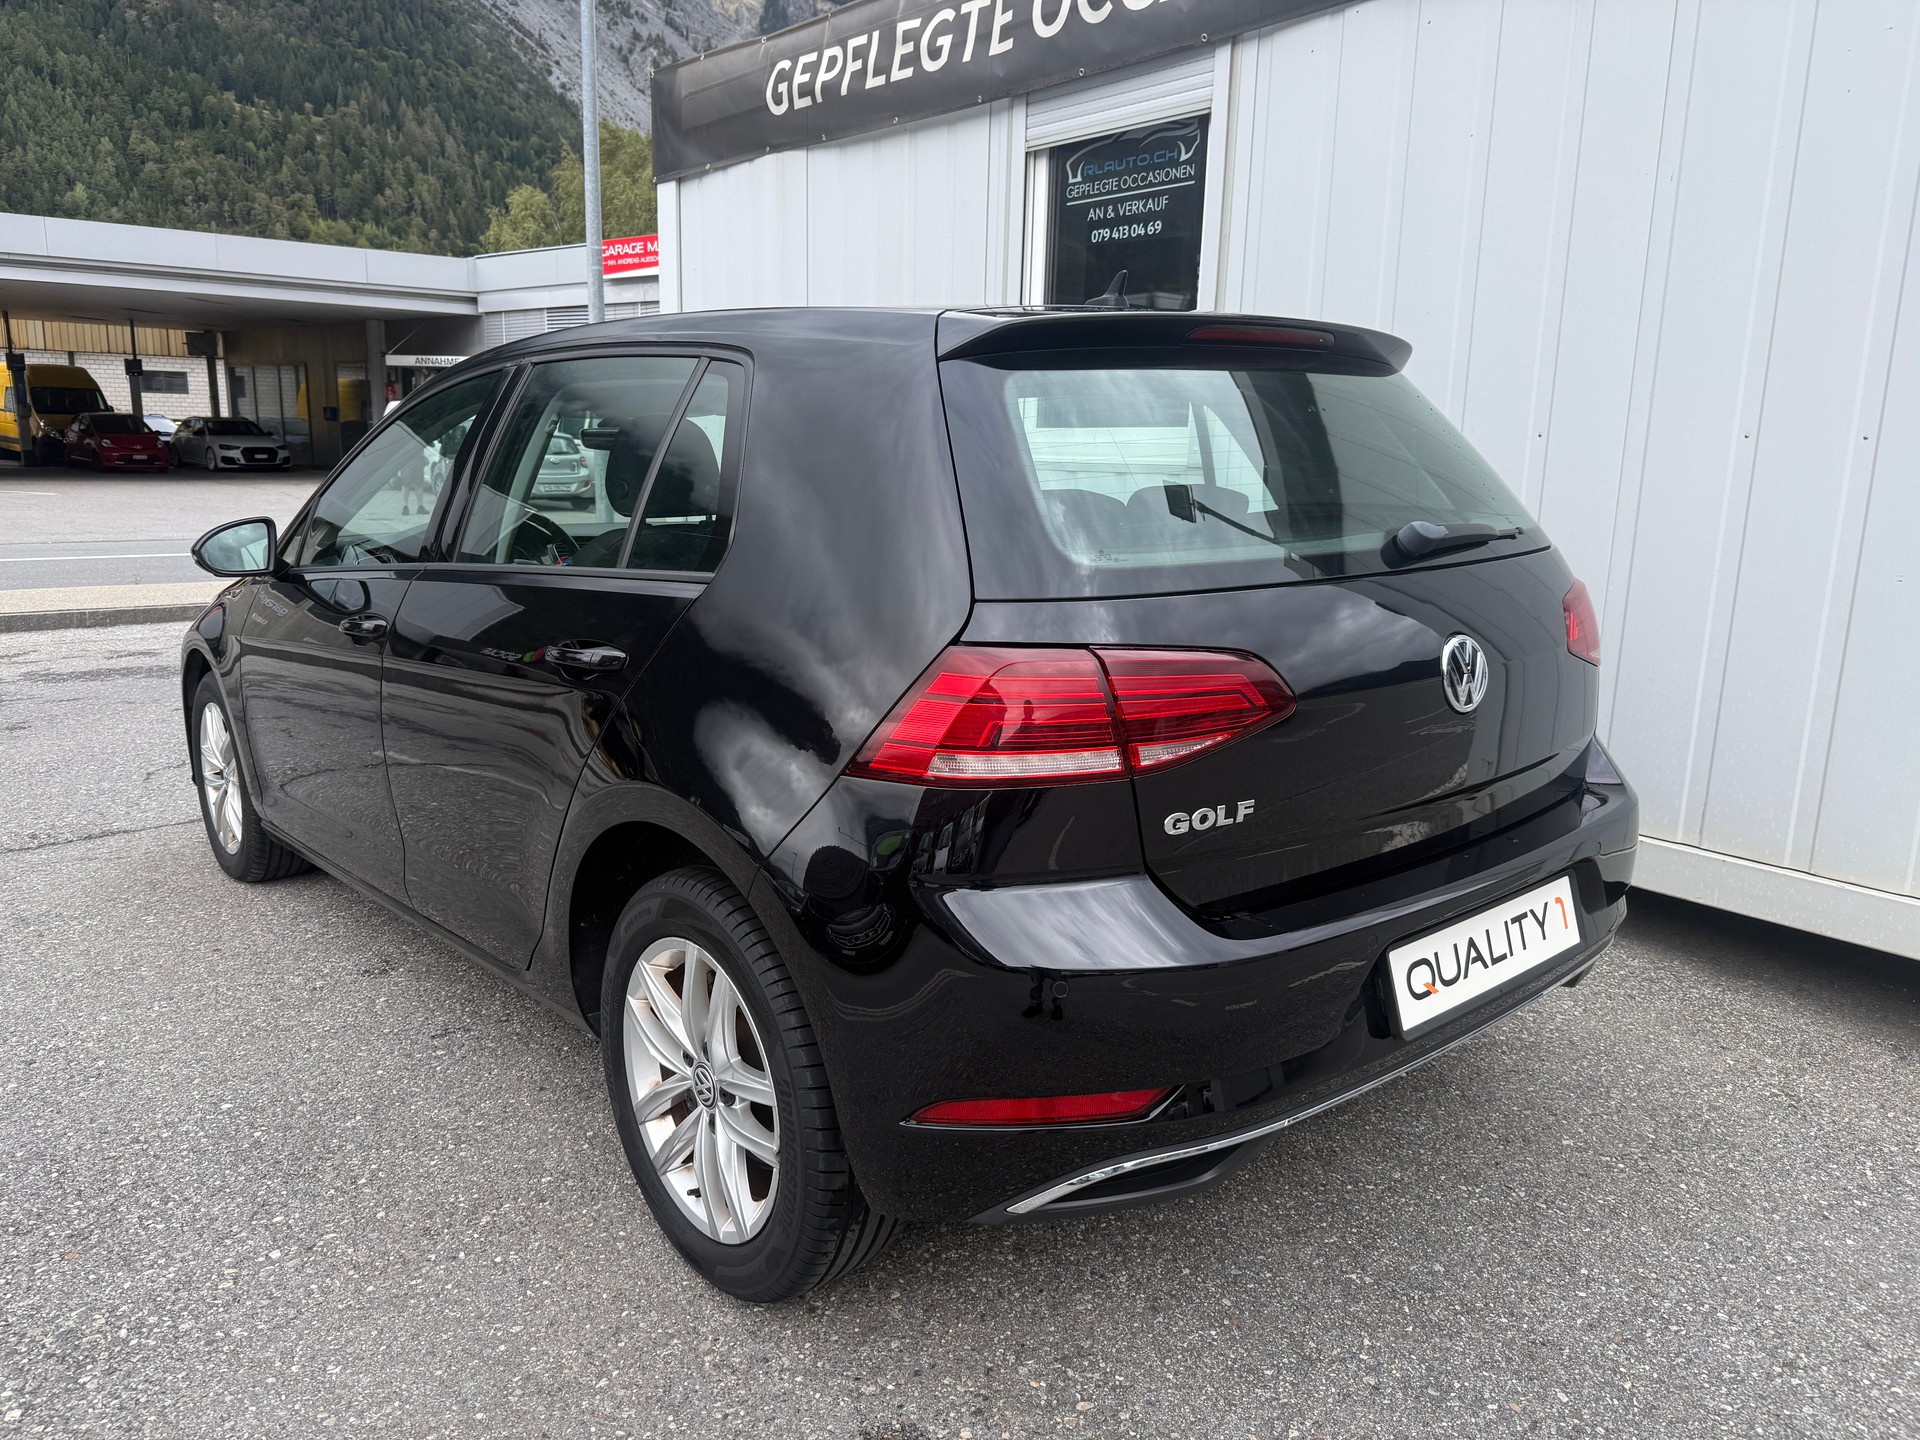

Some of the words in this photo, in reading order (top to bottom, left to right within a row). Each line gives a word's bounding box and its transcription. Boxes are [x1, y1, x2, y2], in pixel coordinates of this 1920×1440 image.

[765, 0, 1014, 116] GEPFLEGTE
[1083, 148, 1178, 176] RLAUTO.CH
[1066, 178, 1119, 199] GEPFLEGTE
[1120, 163, 1195, 189] OCCASIONEN
[1087, 206, 1104, 221] AN
[1106, 205, 1115, 219] &
[1118, 195, 1169, 216] VERKAUF
[1091, 228, 1110, 243] 079
[1112, 226, 1129, 240] 413
[1130, 223, 1145, 237] 04
[1147, 220, 1162, 235] 69
[602, 242, 644, 257] GARAGE
[415, 357, 460, 365] ANNAHME
[1164, 799, 1255, 835] GOLF
